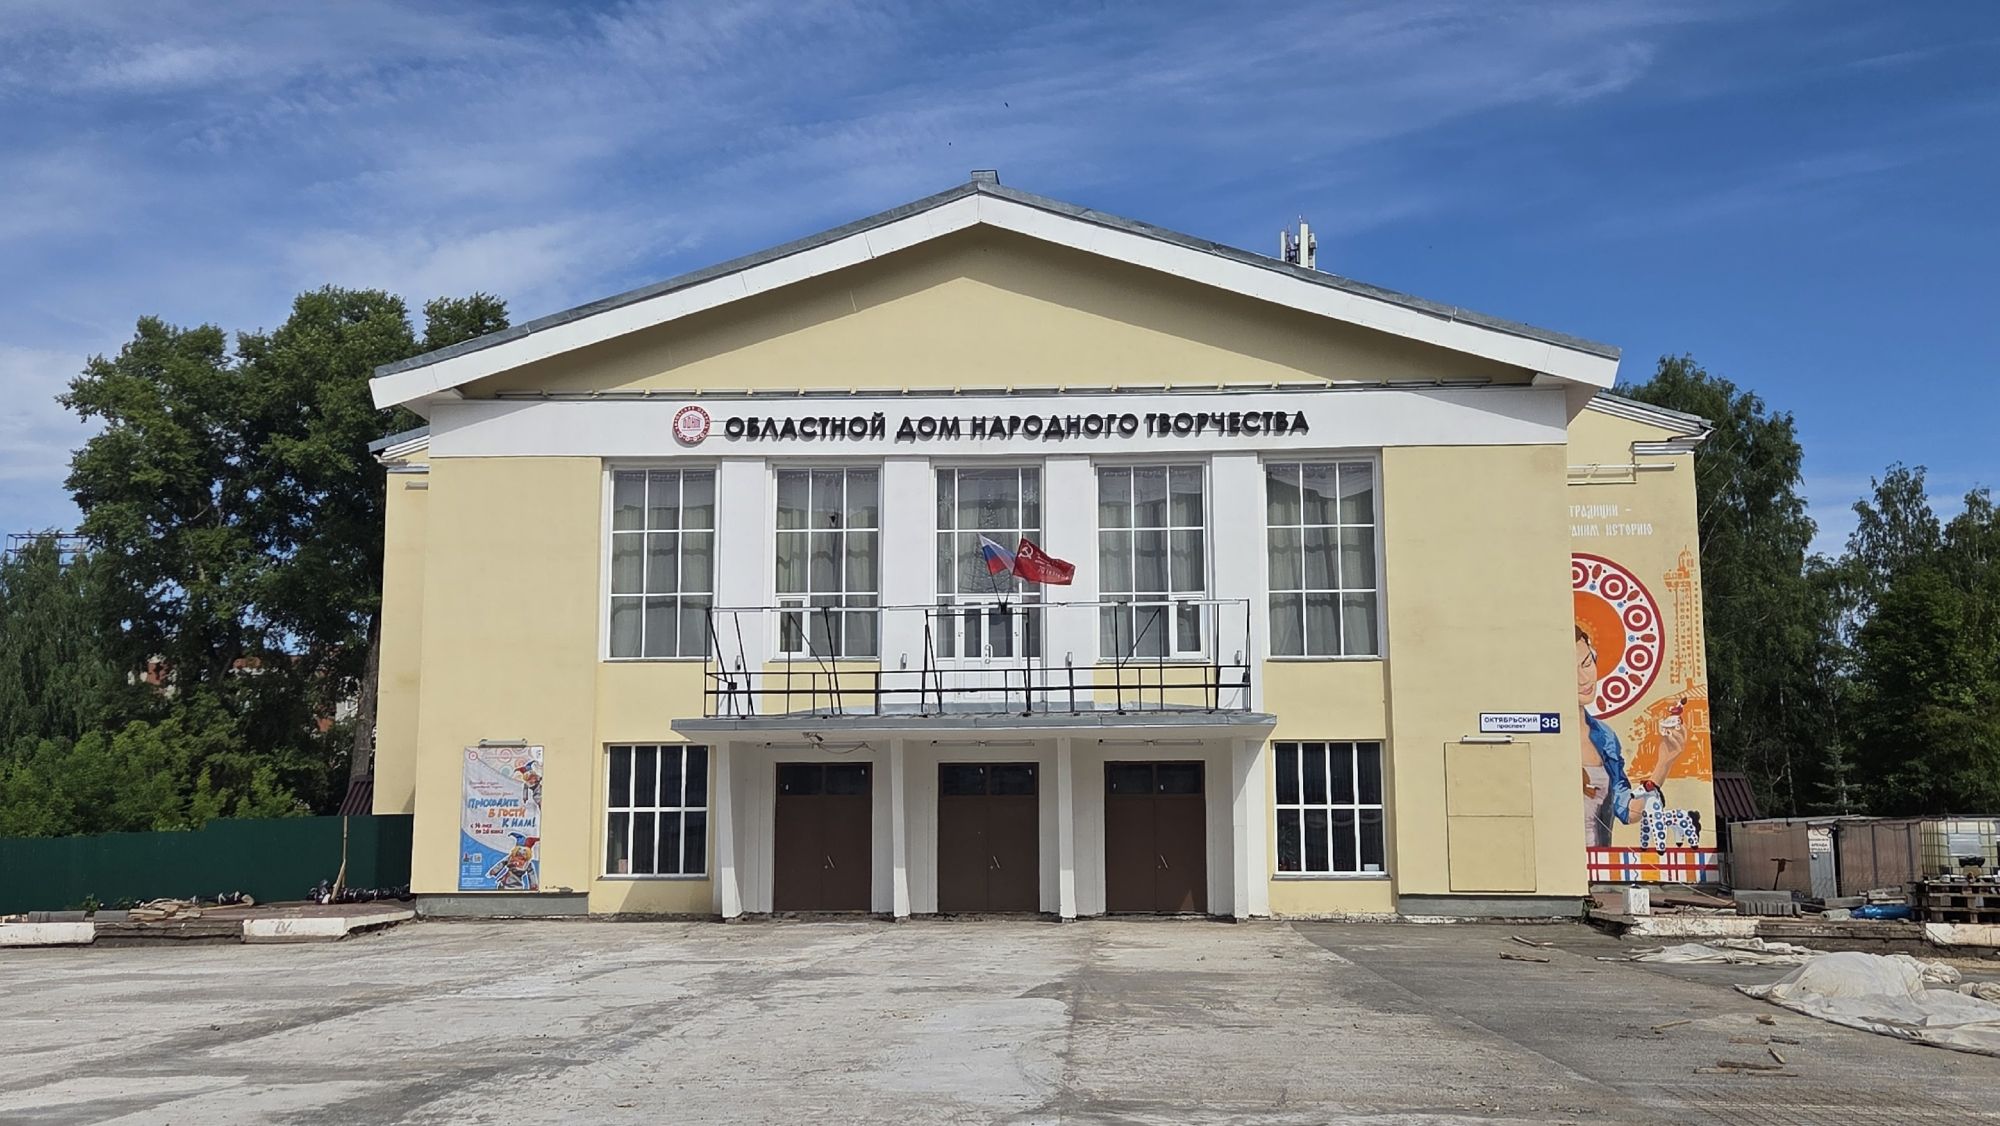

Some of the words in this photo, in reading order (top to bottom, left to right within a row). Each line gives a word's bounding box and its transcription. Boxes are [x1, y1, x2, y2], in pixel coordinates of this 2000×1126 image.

[725, 412, 886, 438] ОБЛАСТНОЙ
[897, 415, 961, 439] ДОМ
[972, 413, 1139, 439] НАРОДНОГО
[1146, 411, 1310, 435] ТВОРЧЕСТВА
[1541, 717, 1559, 728] 38
[488, 808, 495, 818] В
[498, 807, 526, 818] ГОСТИ
[502, 817, 510, 828] К
[511, 817, 536, 828] НАМ!
